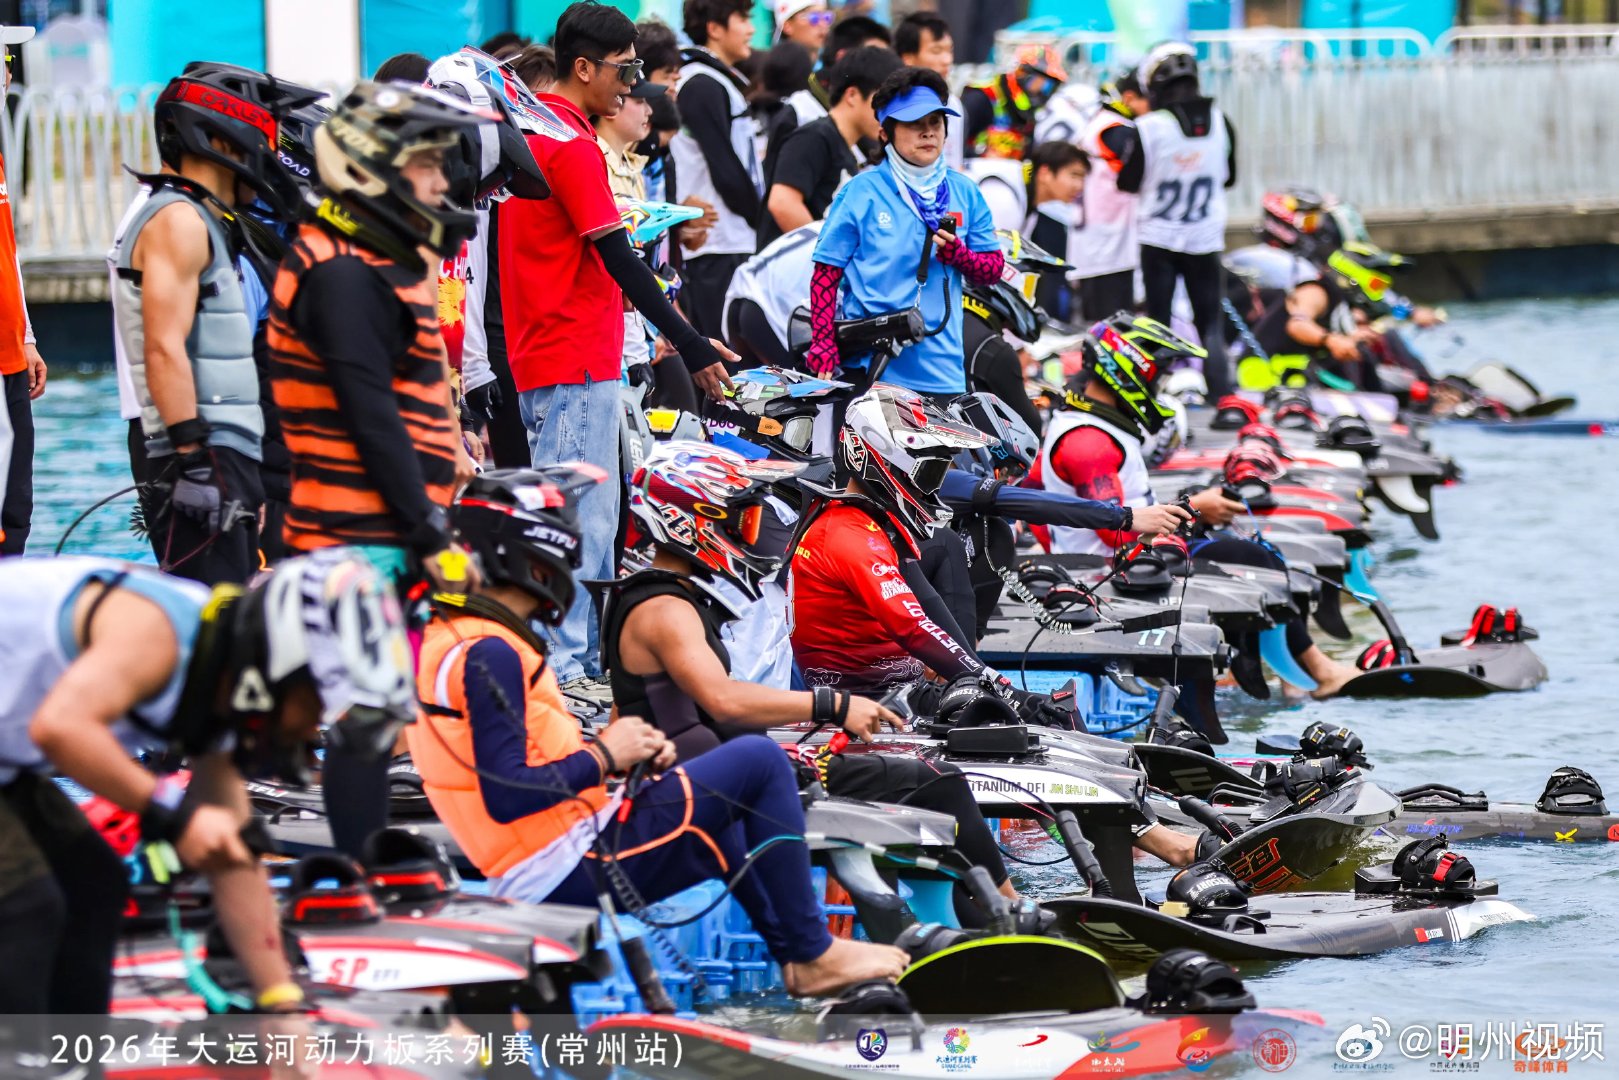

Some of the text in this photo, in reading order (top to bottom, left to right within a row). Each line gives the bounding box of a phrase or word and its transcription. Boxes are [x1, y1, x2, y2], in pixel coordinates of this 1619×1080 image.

[201, 91, 271, 128] OAKLEY
[1153, 176, 1213, 222] 20
[326, 957, 370, 985] SP
